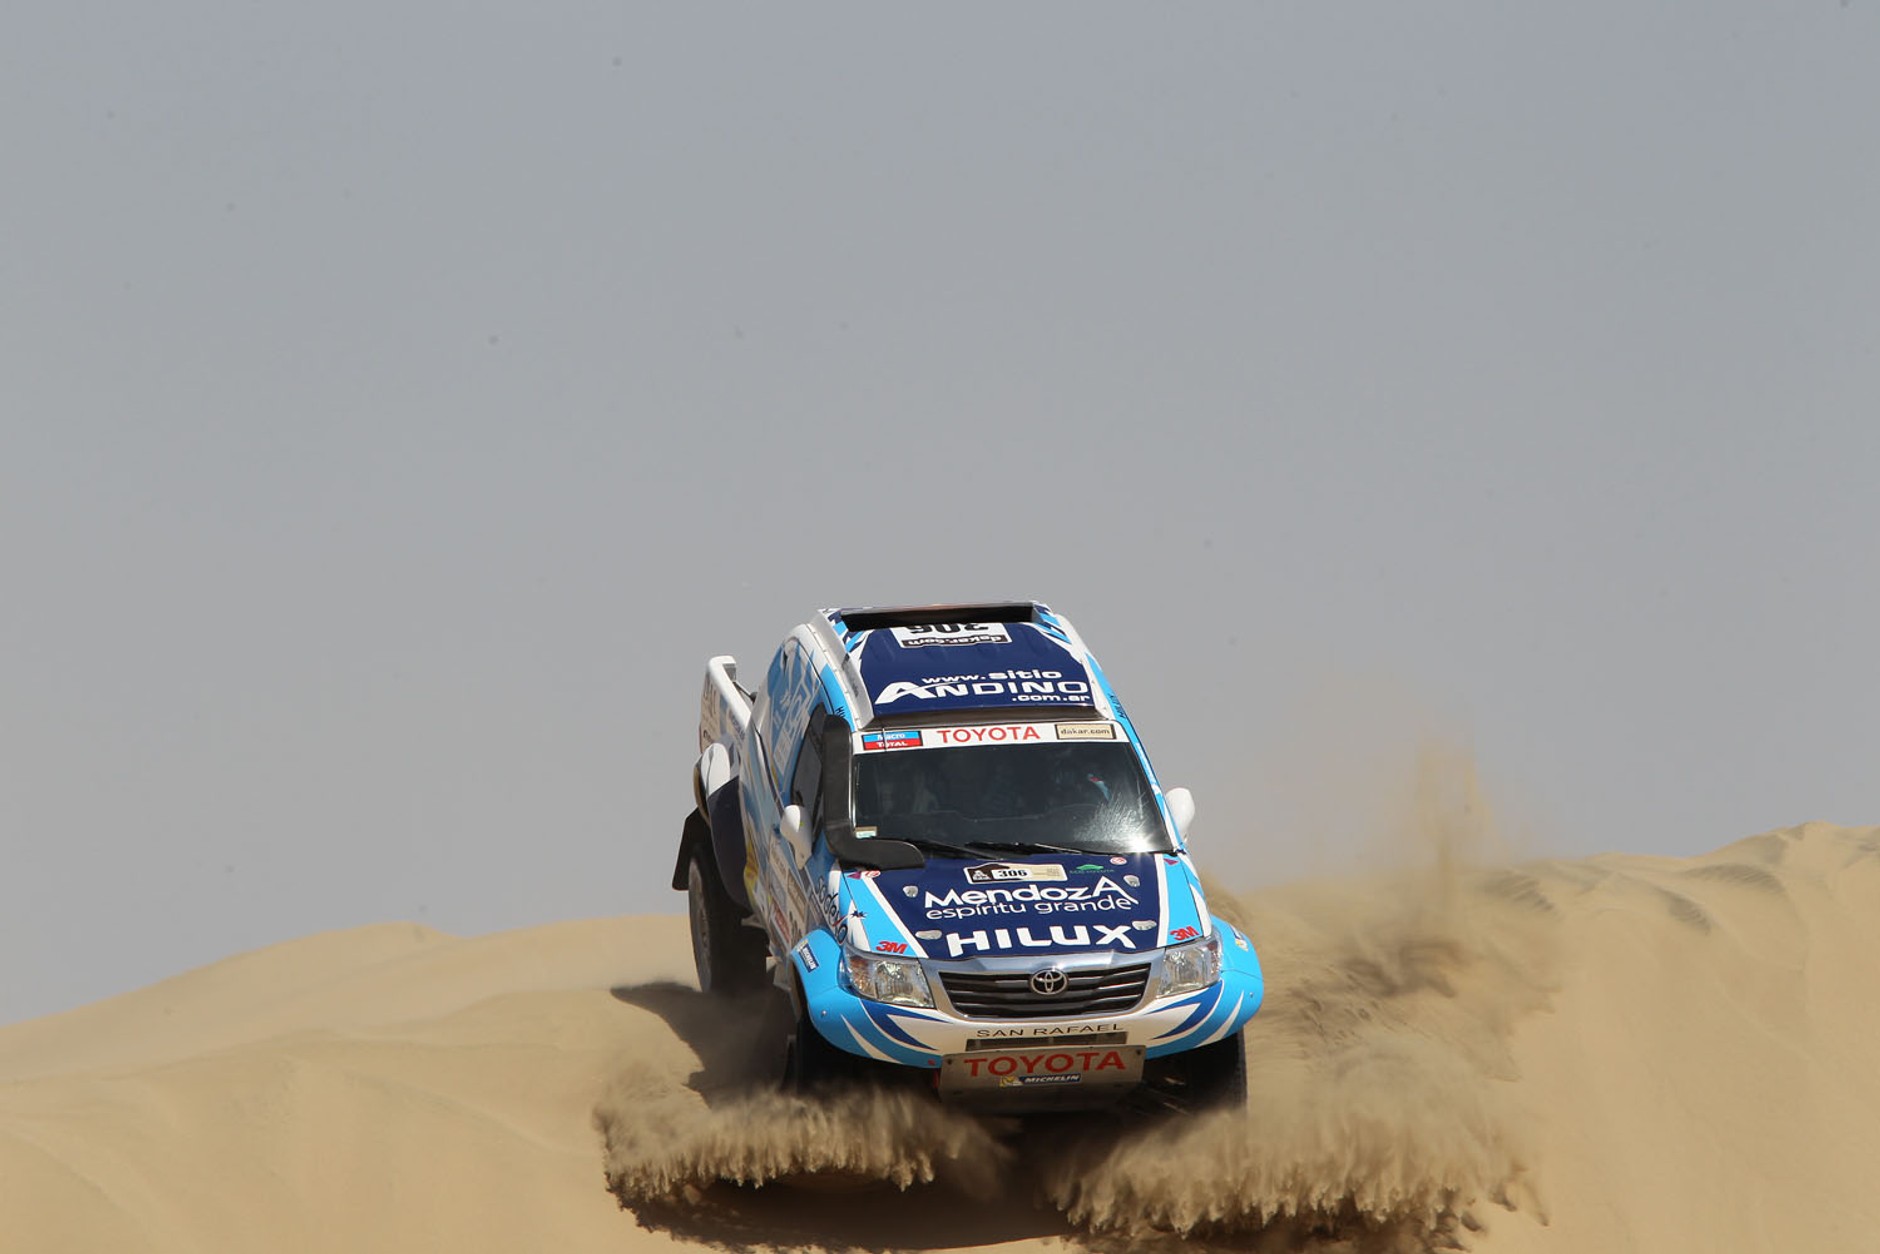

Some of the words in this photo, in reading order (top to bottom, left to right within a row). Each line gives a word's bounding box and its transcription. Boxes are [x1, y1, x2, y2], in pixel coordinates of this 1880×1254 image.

[908, 635, 1002, 646] dakar.com
[922, 669, 1062, 684] www.sitio
[875, 681, 1089, 704] ANDINO
[1012, 694, 1090, 703] .com.ar
[937, 726, 1040, 743] TOYOTA
[998, 869, 1027, 877] 306
[1034, 895, 1132, 915] grande
[946, 925, 1136, 957] HILUX
[1170, 926, 1200, 941] 3M
[876, 941, 908, 954] 3M
[977, 1028, 1024, 1038] SAN
[1033, 1023, 1124, 1036] RAFAEL
[964, 1051, 1126, 1077] TOYOTA
[1025, 1075, 1080, 1083] MICHELIN
